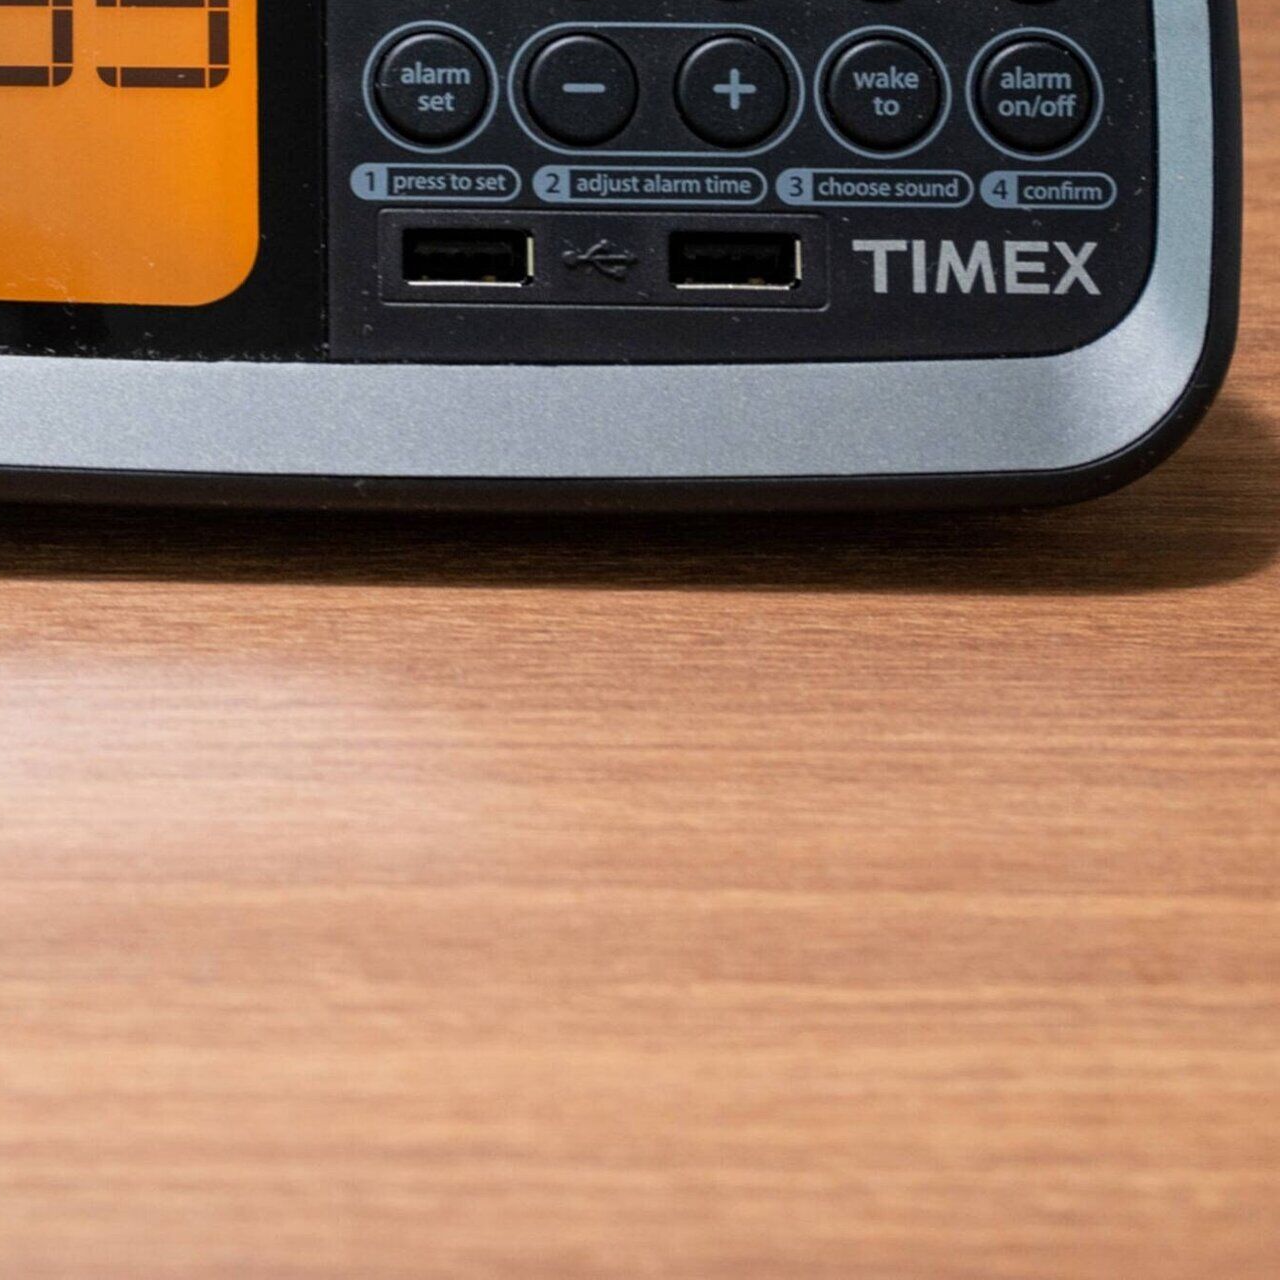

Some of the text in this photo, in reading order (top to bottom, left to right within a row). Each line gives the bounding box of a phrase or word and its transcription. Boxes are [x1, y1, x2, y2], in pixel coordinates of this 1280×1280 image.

[400, 60, 471, 85] alarm
[852, 65, 920, 90] wake
[999, 65, 1072, 90] alarm
[417, 91, 455, 112] set
[872, 96, 901, 117] to
[997, 93, 1077, 118] on/off
[365, 170, 507, 197] 1 press to set
[545, 172, 752, 199] 2 adjust alarm time
[789, 175, 959, 198] 3 choose sound
[991, 179, 1103, 201] 4 confirm
[851, 239, 1101, 295] TIMEX
